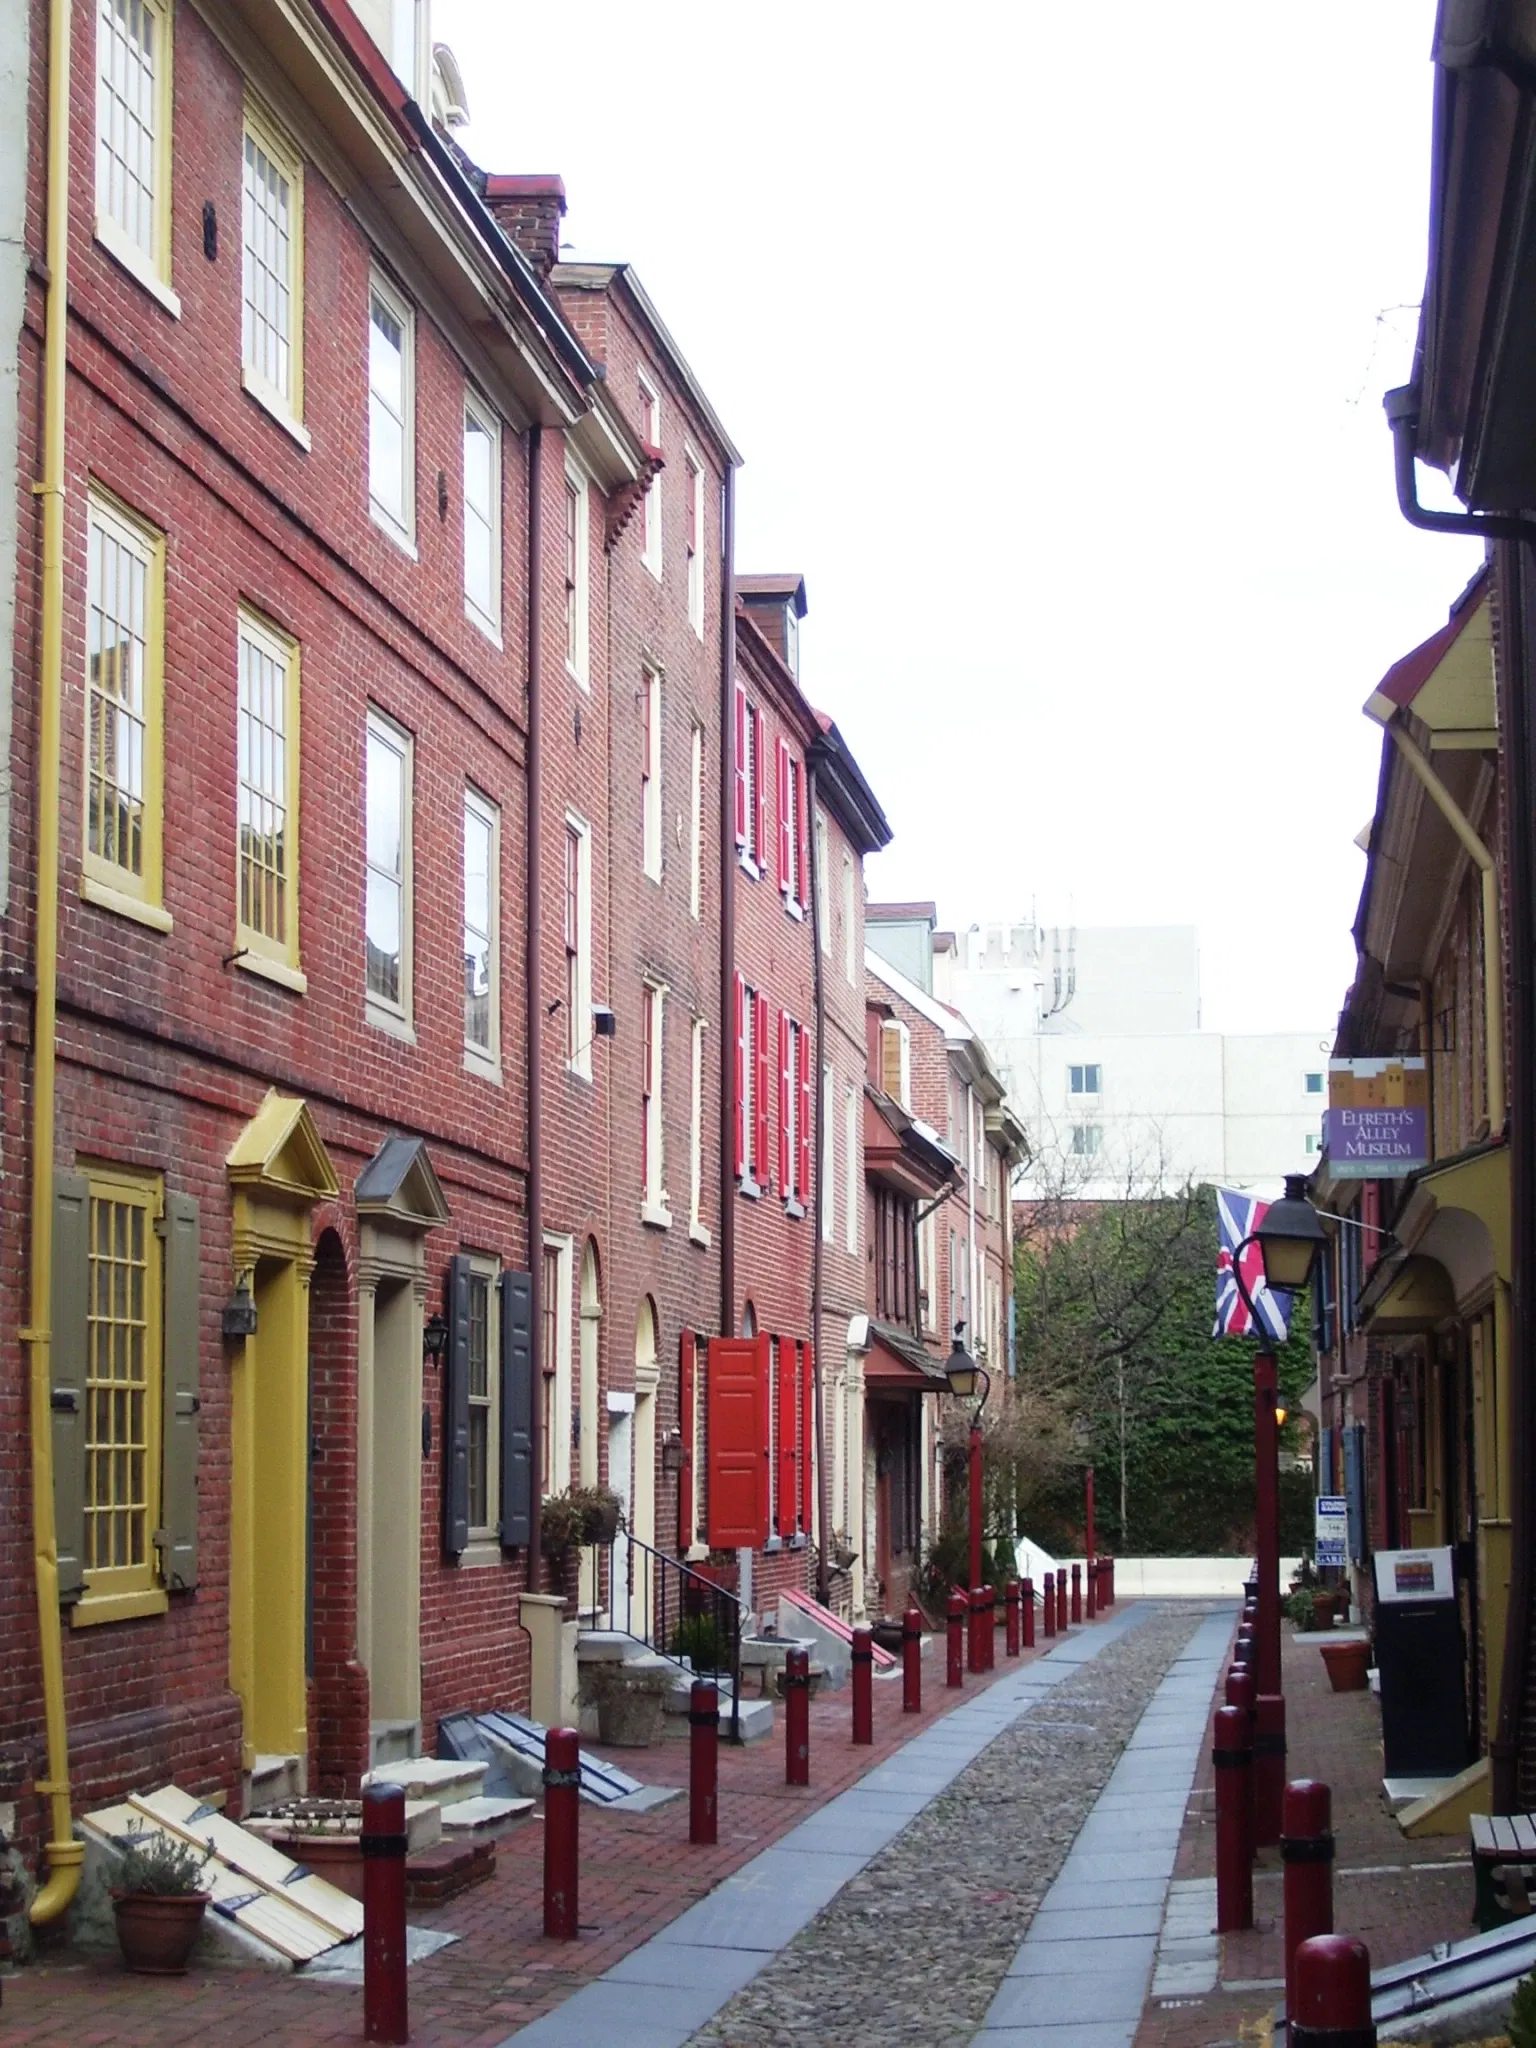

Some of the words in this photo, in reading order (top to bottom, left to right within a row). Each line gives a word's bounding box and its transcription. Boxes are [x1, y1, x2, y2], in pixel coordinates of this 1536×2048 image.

[1342, 1110, 1414, 1126] ELFRETH'S
[1355, 1126, 1401, 1140] ALLEY
[1346, 1141, 1411, 1156] MUSEUM
